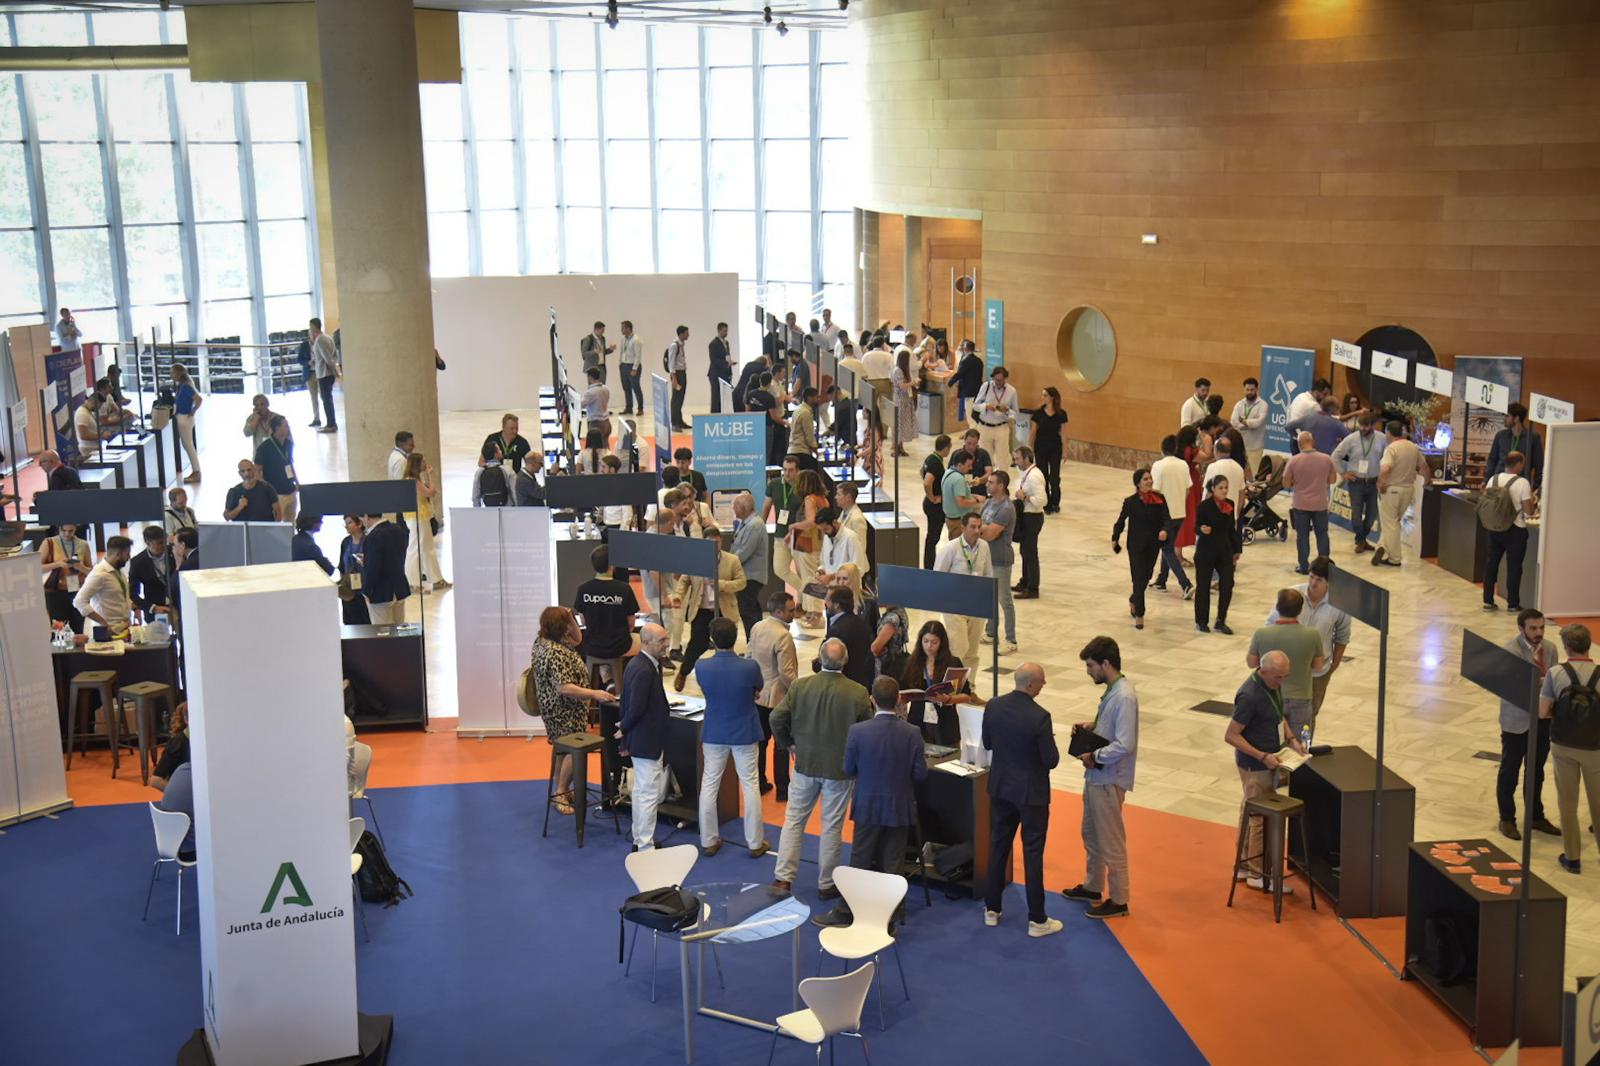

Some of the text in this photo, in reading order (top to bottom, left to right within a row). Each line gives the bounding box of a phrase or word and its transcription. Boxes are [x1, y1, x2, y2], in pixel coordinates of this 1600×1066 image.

[704, 421, 753, 437] MÜBE
[227, 907, 344, 935] Junta de Andalucía
